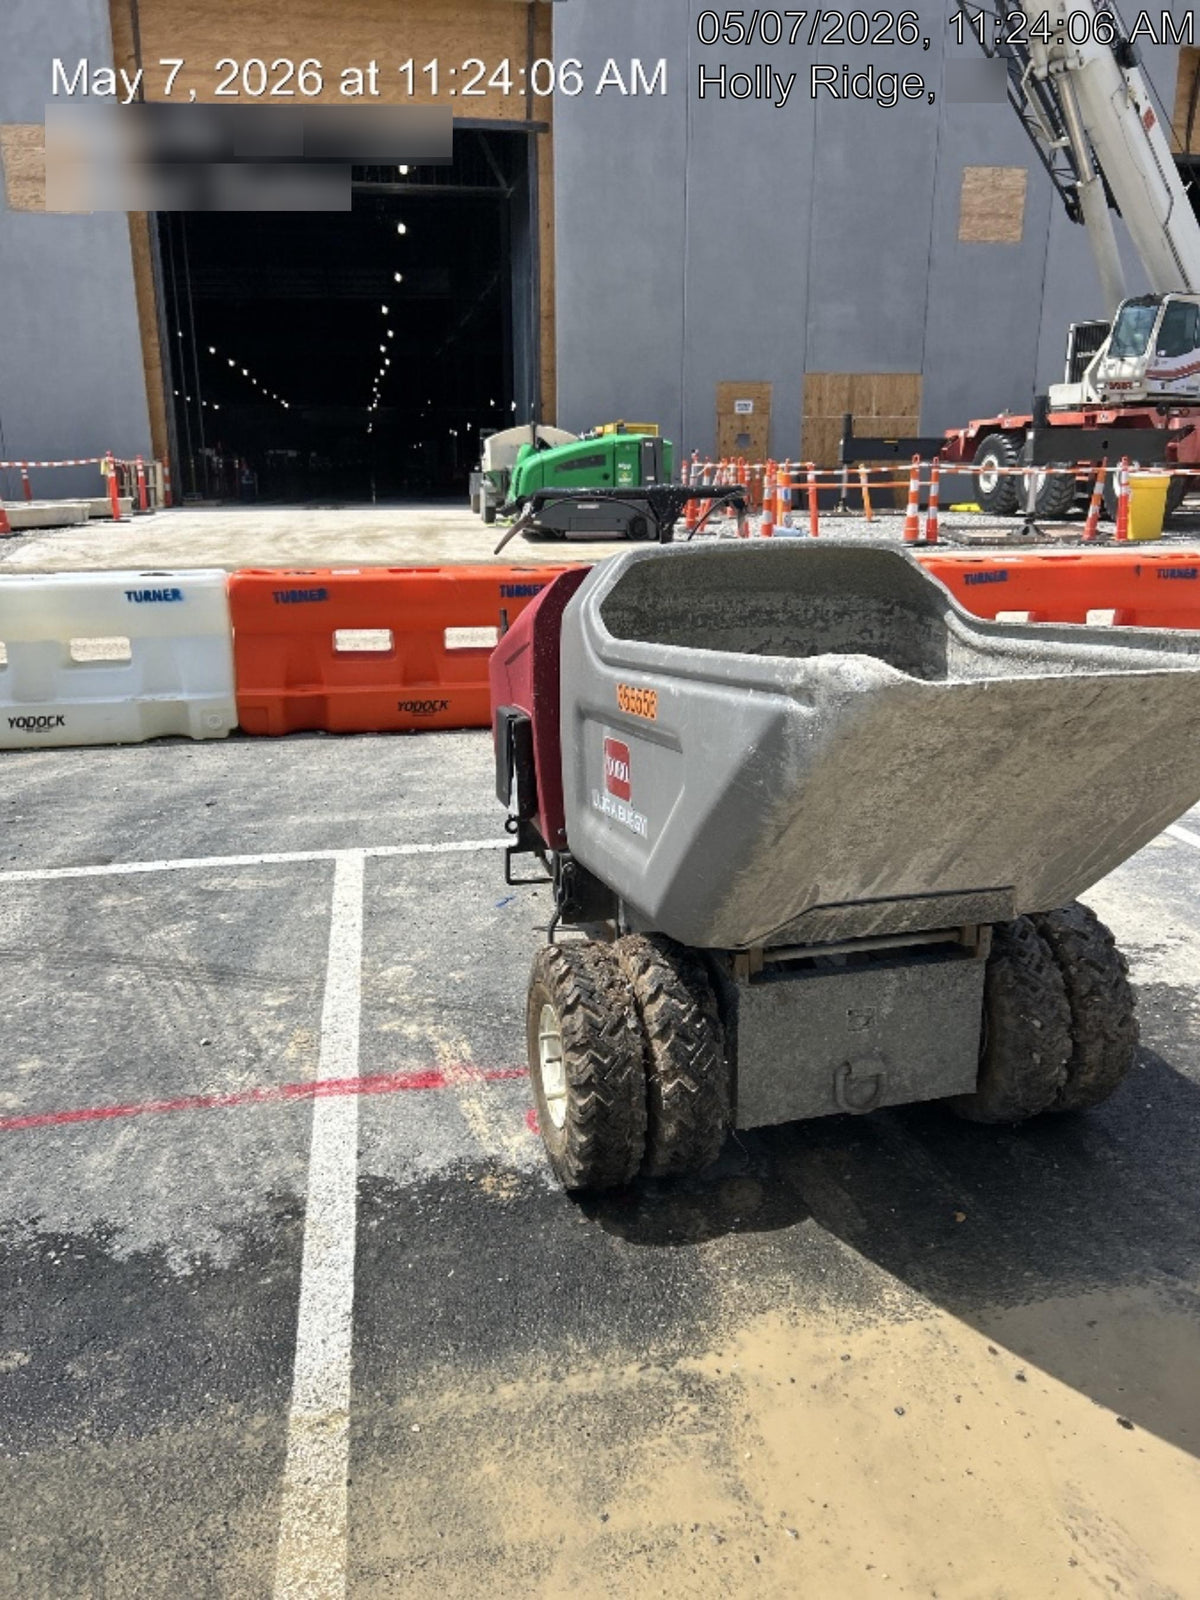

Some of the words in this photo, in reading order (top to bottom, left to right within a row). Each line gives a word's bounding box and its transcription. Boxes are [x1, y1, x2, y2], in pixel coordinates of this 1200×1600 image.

[963, 569, 1008, 586] TURNER
[1157, 568, 1198, 580] TURNER
[124, 588, 183, 603] TURNER
[272, 588, 328, 604] TURNER
[499, 584, 545, 598] TURNE
[397, 699, 449, 713] YODOCK
[8, 714, 66, 729] YODOCK
